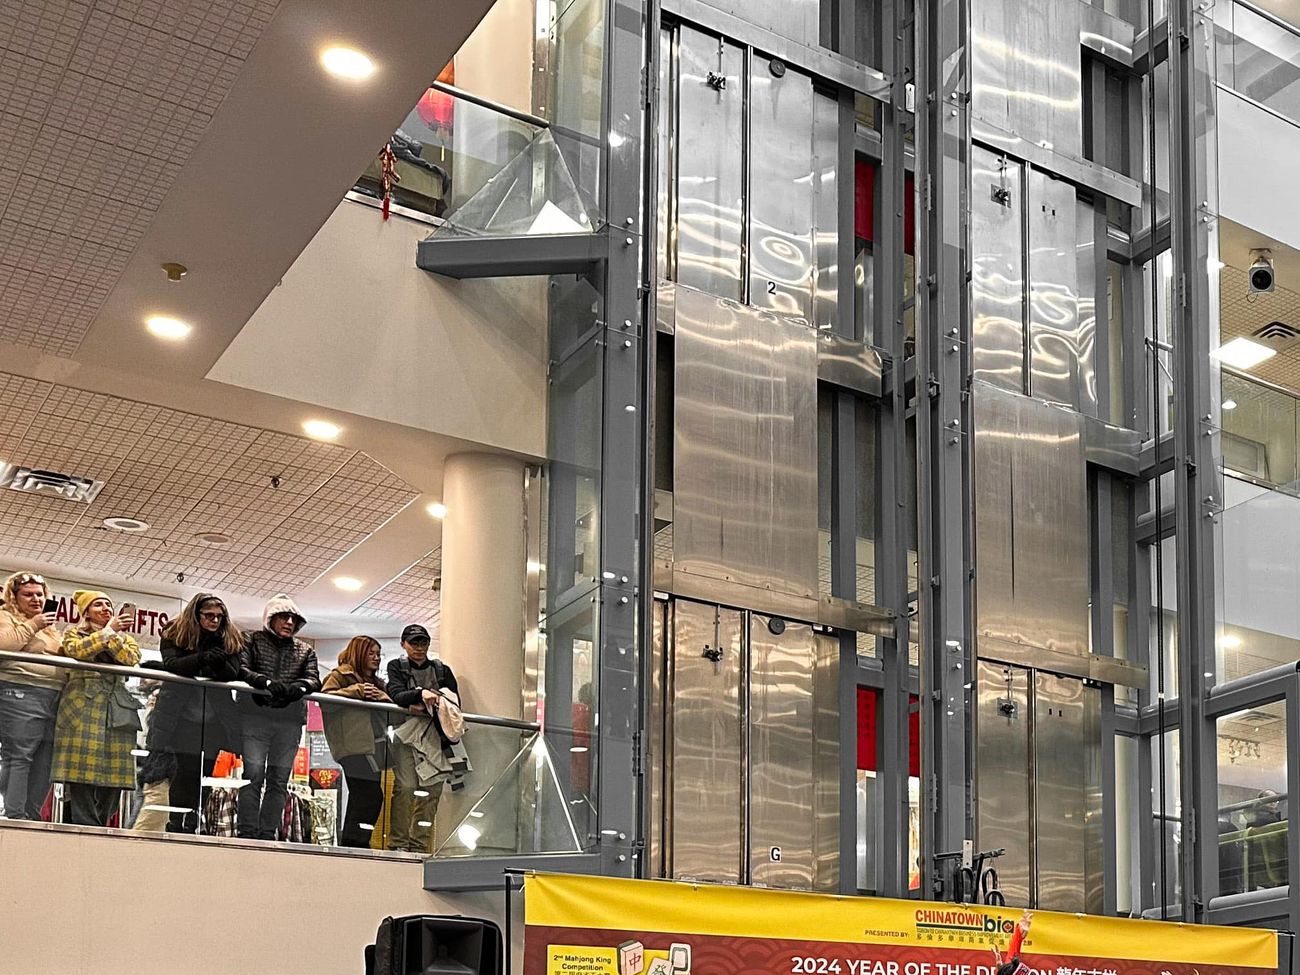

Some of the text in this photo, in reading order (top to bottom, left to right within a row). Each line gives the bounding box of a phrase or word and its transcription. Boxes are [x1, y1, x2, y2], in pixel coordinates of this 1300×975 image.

[768, 281, 776, 295] 2
[771, 847, 780, 861] G
[865, 929, 899, 938] PRESENTED
[562, 963, 603, 971] Competition
[565, 955, 594, 964] Mahjong
[595, 956, 612, 965] King
[629, 952, 642, 971] 中
[791, 957, 841, 975] 2024
